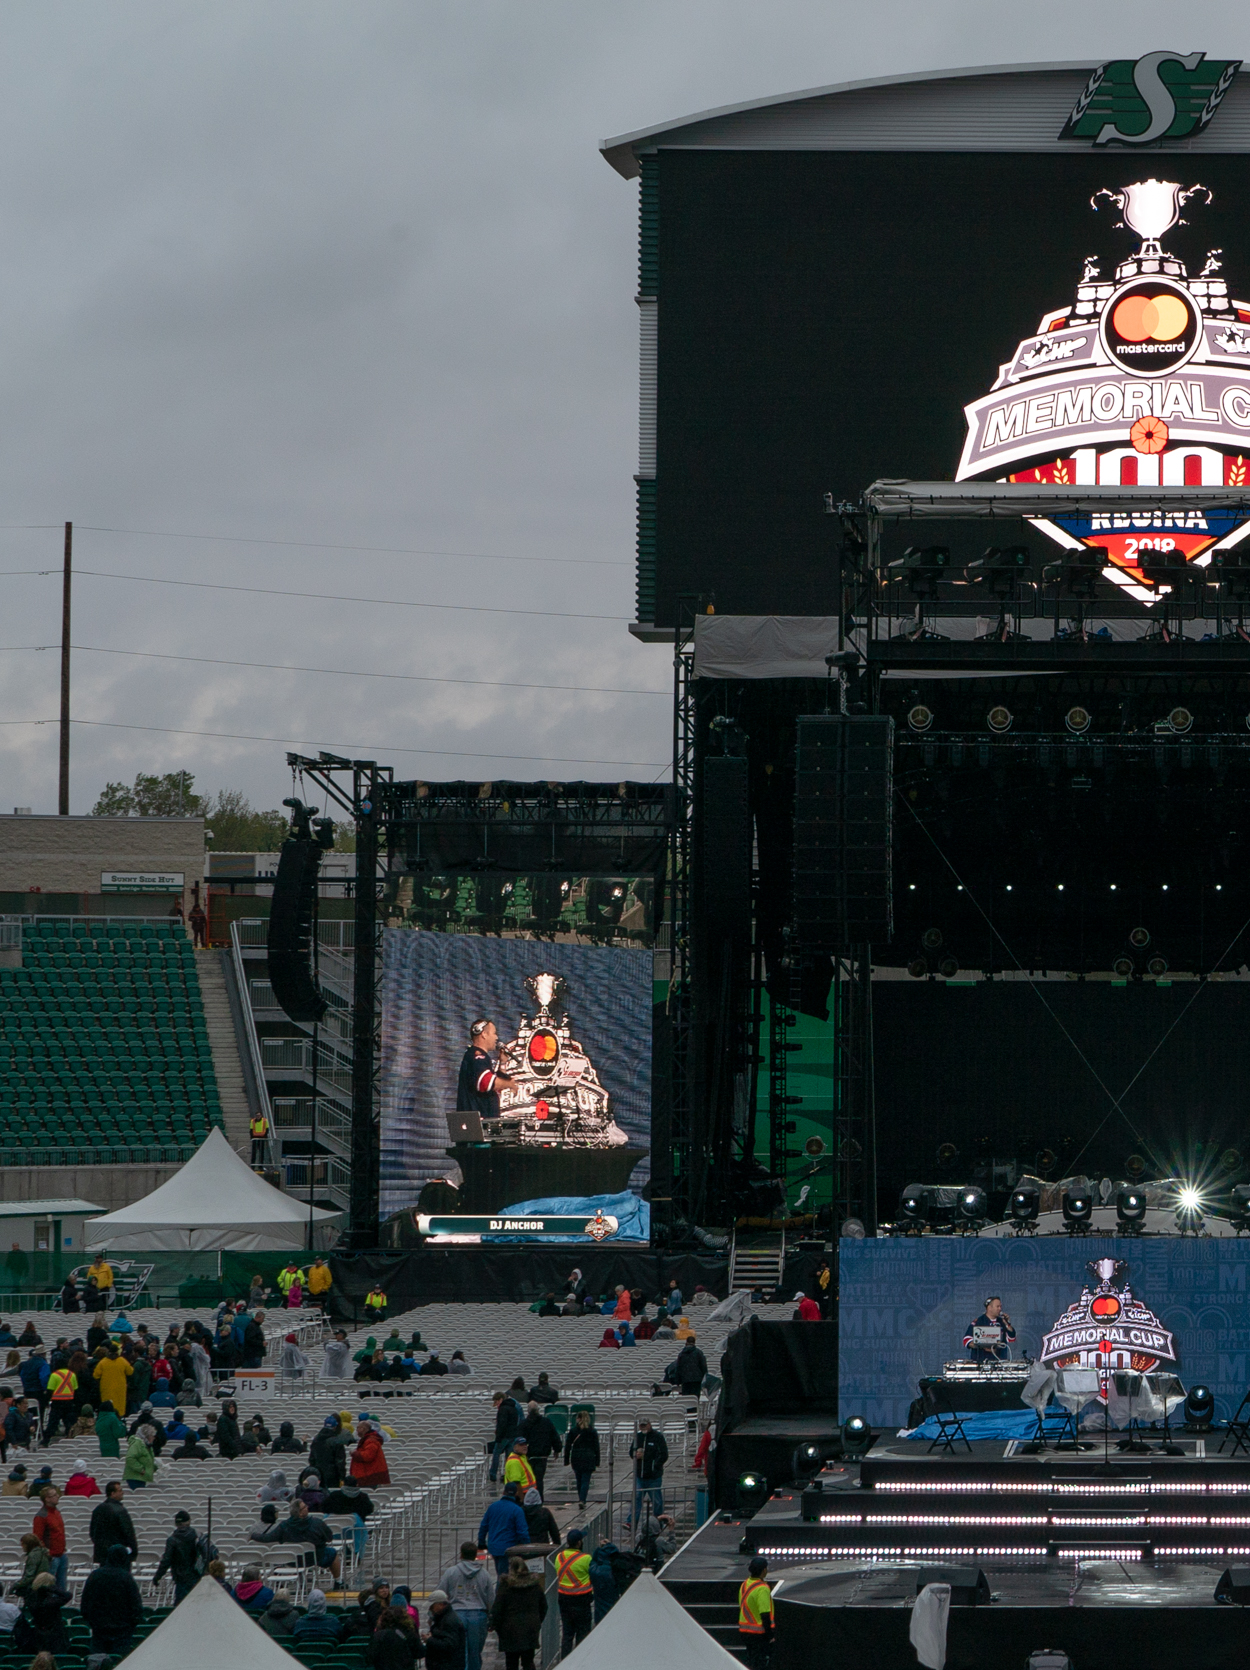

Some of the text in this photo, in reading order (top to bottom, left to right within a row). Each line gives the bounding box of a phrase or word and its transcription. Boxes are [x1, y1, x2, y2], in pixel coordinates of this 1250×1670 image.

[1116, 341, 1186, 354] mastercard
[983, 382, 1221, 449] MEMORIAL
[490, 1220, 503, 1230] DJ
[1194, 1293, 1244, 1304] STRONG
[839, 1308, 919, 1337] MMC
[1049, 1328, 1166, 1351] MEMORIAL CUP
[241, 1379, 269, 1392] FL-3
